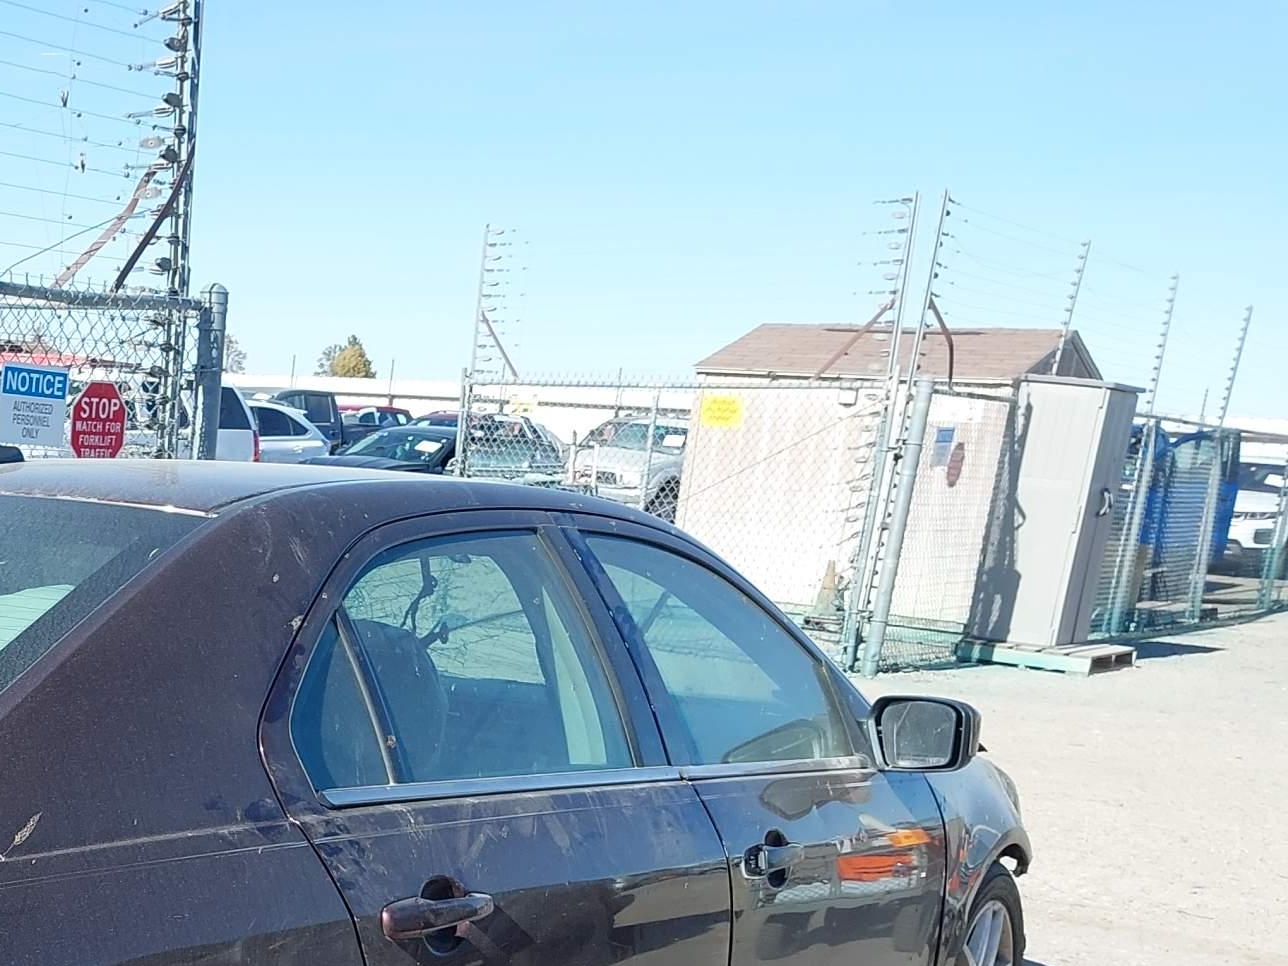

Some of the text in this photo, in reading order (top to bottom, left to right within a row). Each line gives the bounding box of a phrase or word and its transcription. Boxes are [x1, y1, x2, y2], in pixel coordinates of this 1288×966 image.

[6, 370, 64, 396] NOTICE
[13, 400, 53, 415] AUTHORIZED
[80, 397, 121, 419] STOP
[12, 413, 50, 427] PERSONNEL
[75, 420, 122, 433] WATCH FOR
[21, 427, 40, 439] ONLY
[78, 435, 117, 446] FORKLIFT
[79, 448, 113, 458] TRAFFIC
